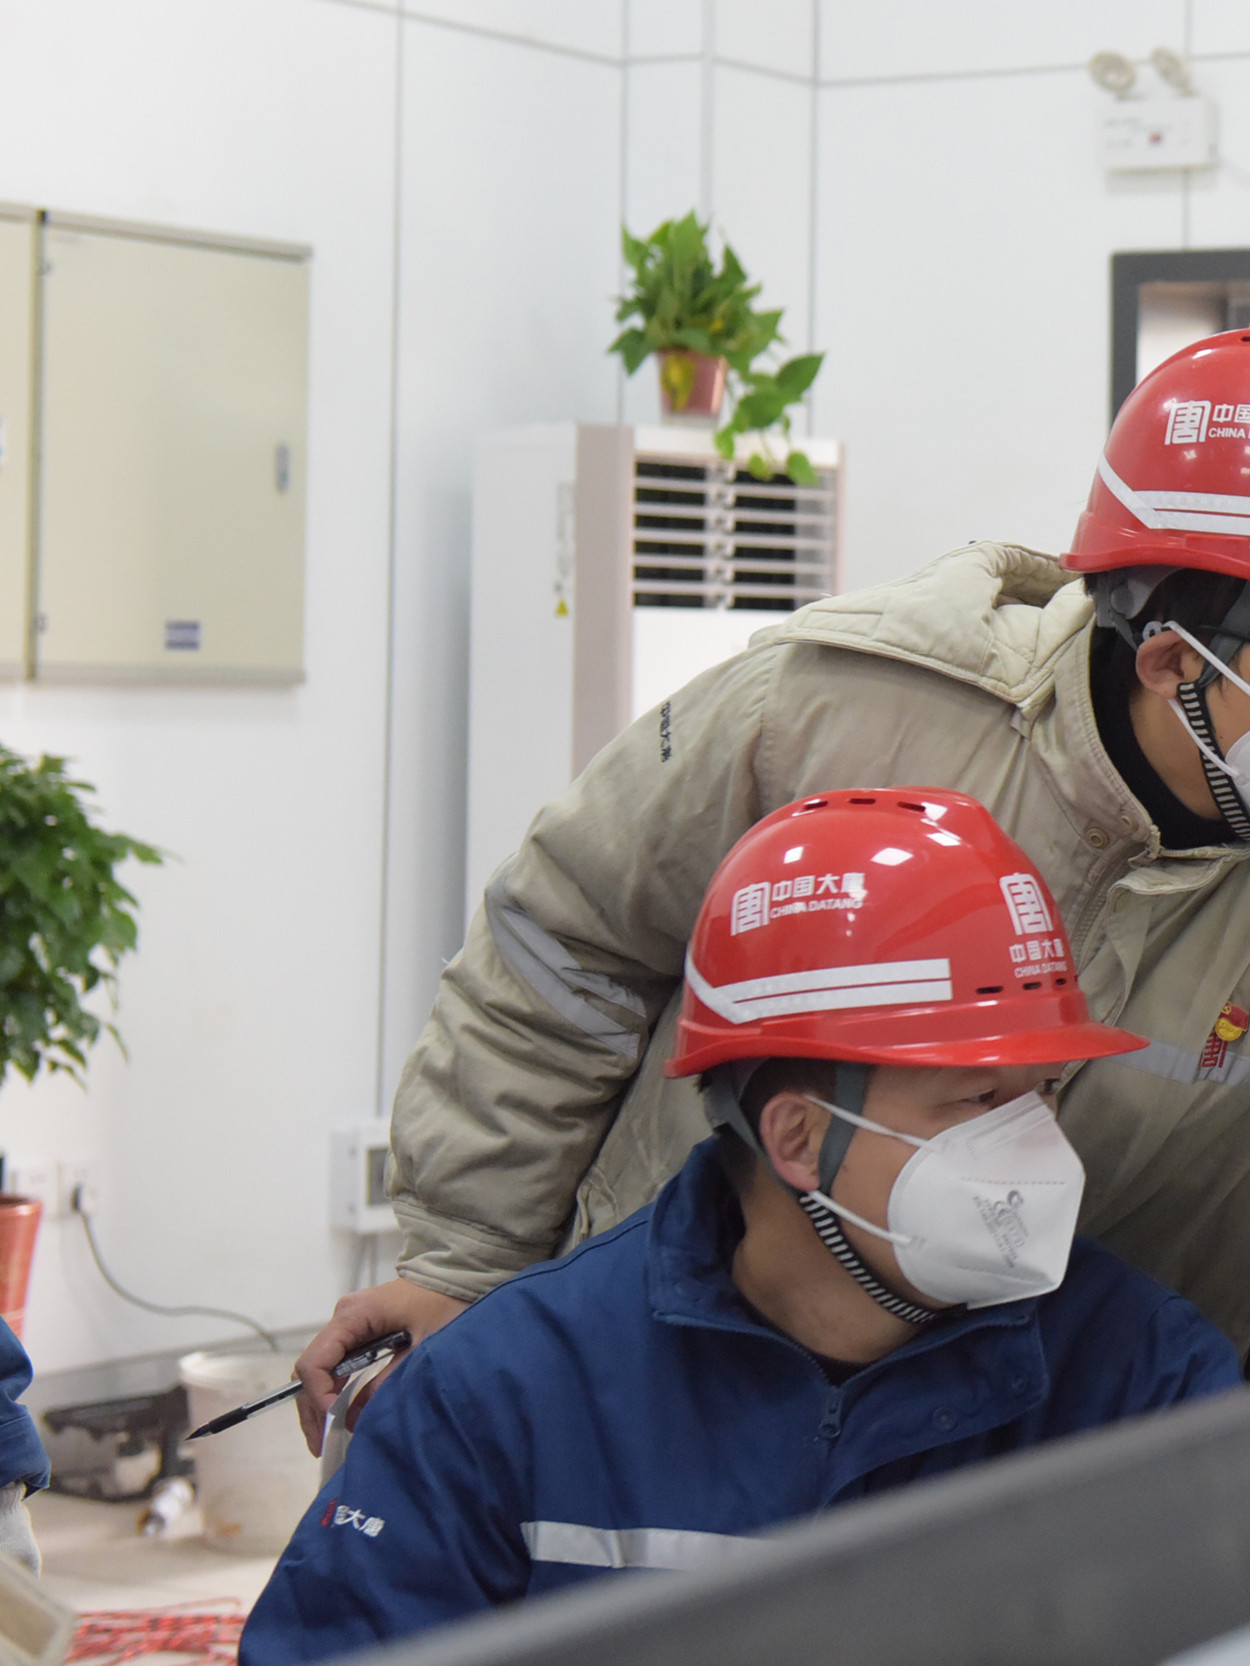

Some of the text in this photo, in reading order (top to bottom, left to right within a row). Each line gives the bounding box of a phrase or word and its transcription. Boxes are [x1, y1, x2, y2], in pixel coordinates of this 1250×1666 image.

[1208, 427, 1246, 438] CHINA
[772, 872, 866, 901] 中国大唐
[770, 899, 864, 919] CHINA DATANG
